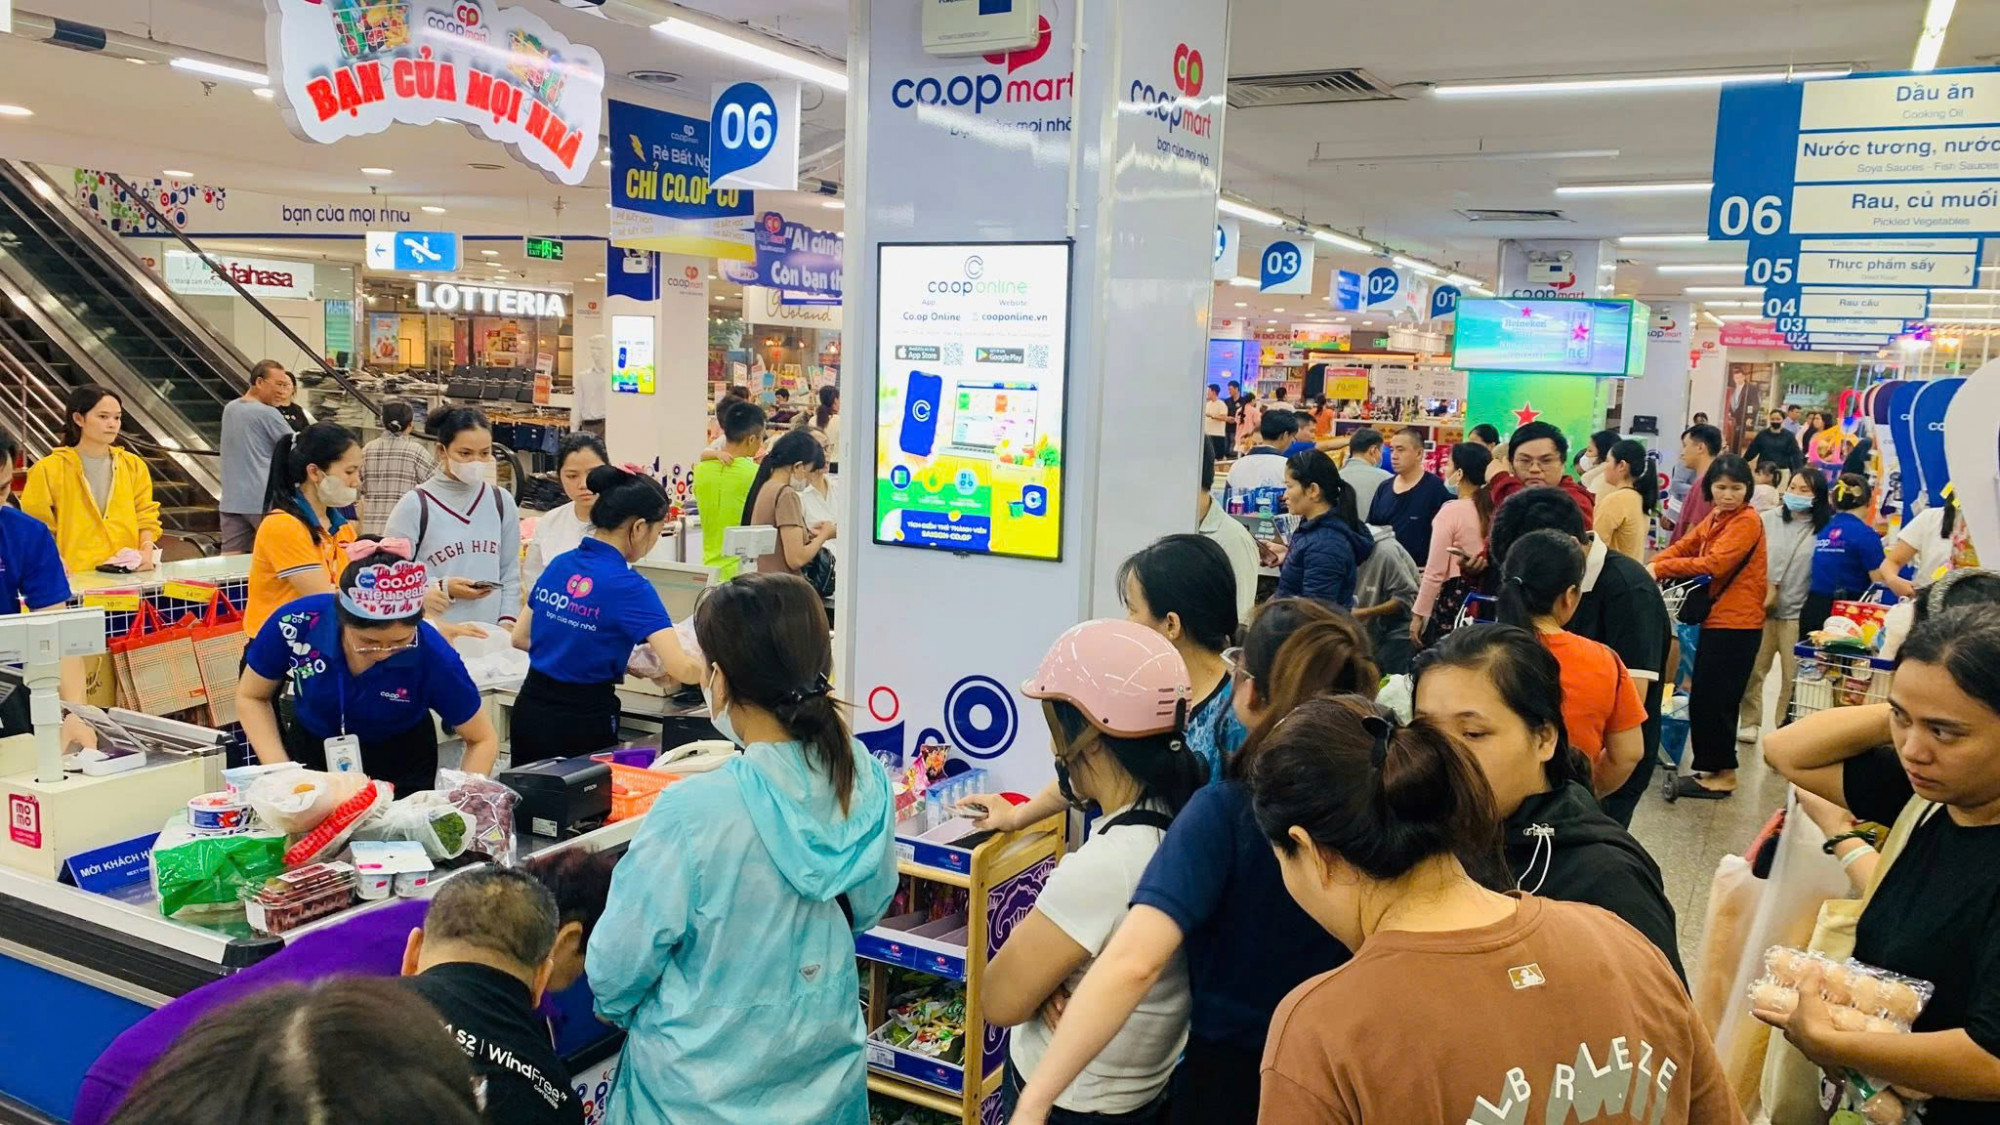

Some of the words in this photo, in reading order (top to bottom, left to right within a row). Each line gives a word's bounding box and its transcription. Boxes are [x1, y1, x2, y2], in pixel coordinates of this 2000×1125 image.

[306, 60, 385, 122] BẠN
[393, 46, 457, 102] CỦA
[465, 69, 523, 124] MỌI
[1896, 82, 1939, 101] Dầu
[1947, 83, 1974, 99] ăn
[1902, 109, 1946, 120] Cooking
[1948, 108, 1964, 118] Oil
[721, 102, 773, 149] 06
[1803, 141, 1860, 156] Nước
[1867, 141, 1937, 157] tương,
[671, 148, 693, 166] Bất
[695, 154, 710, 173] Ng
[1857, 163, 1883, 174] Soya
[1885, 162, 1924, 172] Sauces
[1934, 161, 1956, 171] Fish
[1959, 161, 1999, 170] Sauces
[626, 161, 658, 200] CHỈ
[1852, 193, 1899, 211] Rau,
[1907, 190, 1933, 208] củ
[1941, 187, 1998, 208] muối
[282, 204, 311, 226] bạn
[316, 204, 344, 222] của
[1719, 195, 1783, 235] 06
[1873, 217, 1910, 226] Pickled
[1913, 217, 1971, 227] Vegetables
[1267, 253, 1298, 275] 03
[1751, 257, 1794, 284] 05
[1828, 258, 1863, 272] Thực
[1867, 257, 1906, 271] phẩm
[1911, 257, 1936, 273] sấy
[230, 262, 294, 288] fahasa
[802, 264, 828, 291] bạn
[1370, 275, 1396, 294] 02
[416, 282, 566, 318] LOTTERIA
[1000, 299, 1028, 307] Website
[1436, 291, 1456, 307] 01
[1766, 298, 1797, 317] 04
[903, 311, 928, 321] Co.op
[931, 311, 961, 322] Online
[982, 311, 1048, 322] cooponline.vn
[1779, 317, 1804, 332] 03
[1787, 333, 1809, 343] 02
[921, 352, 938, 360] Store
[472, 540, 500, 554] HIE
[80, 864, 102, 877] MỜI
[102, 853, 139, 871] KHÁCH
[456, 1029, 477, 1051] S2
